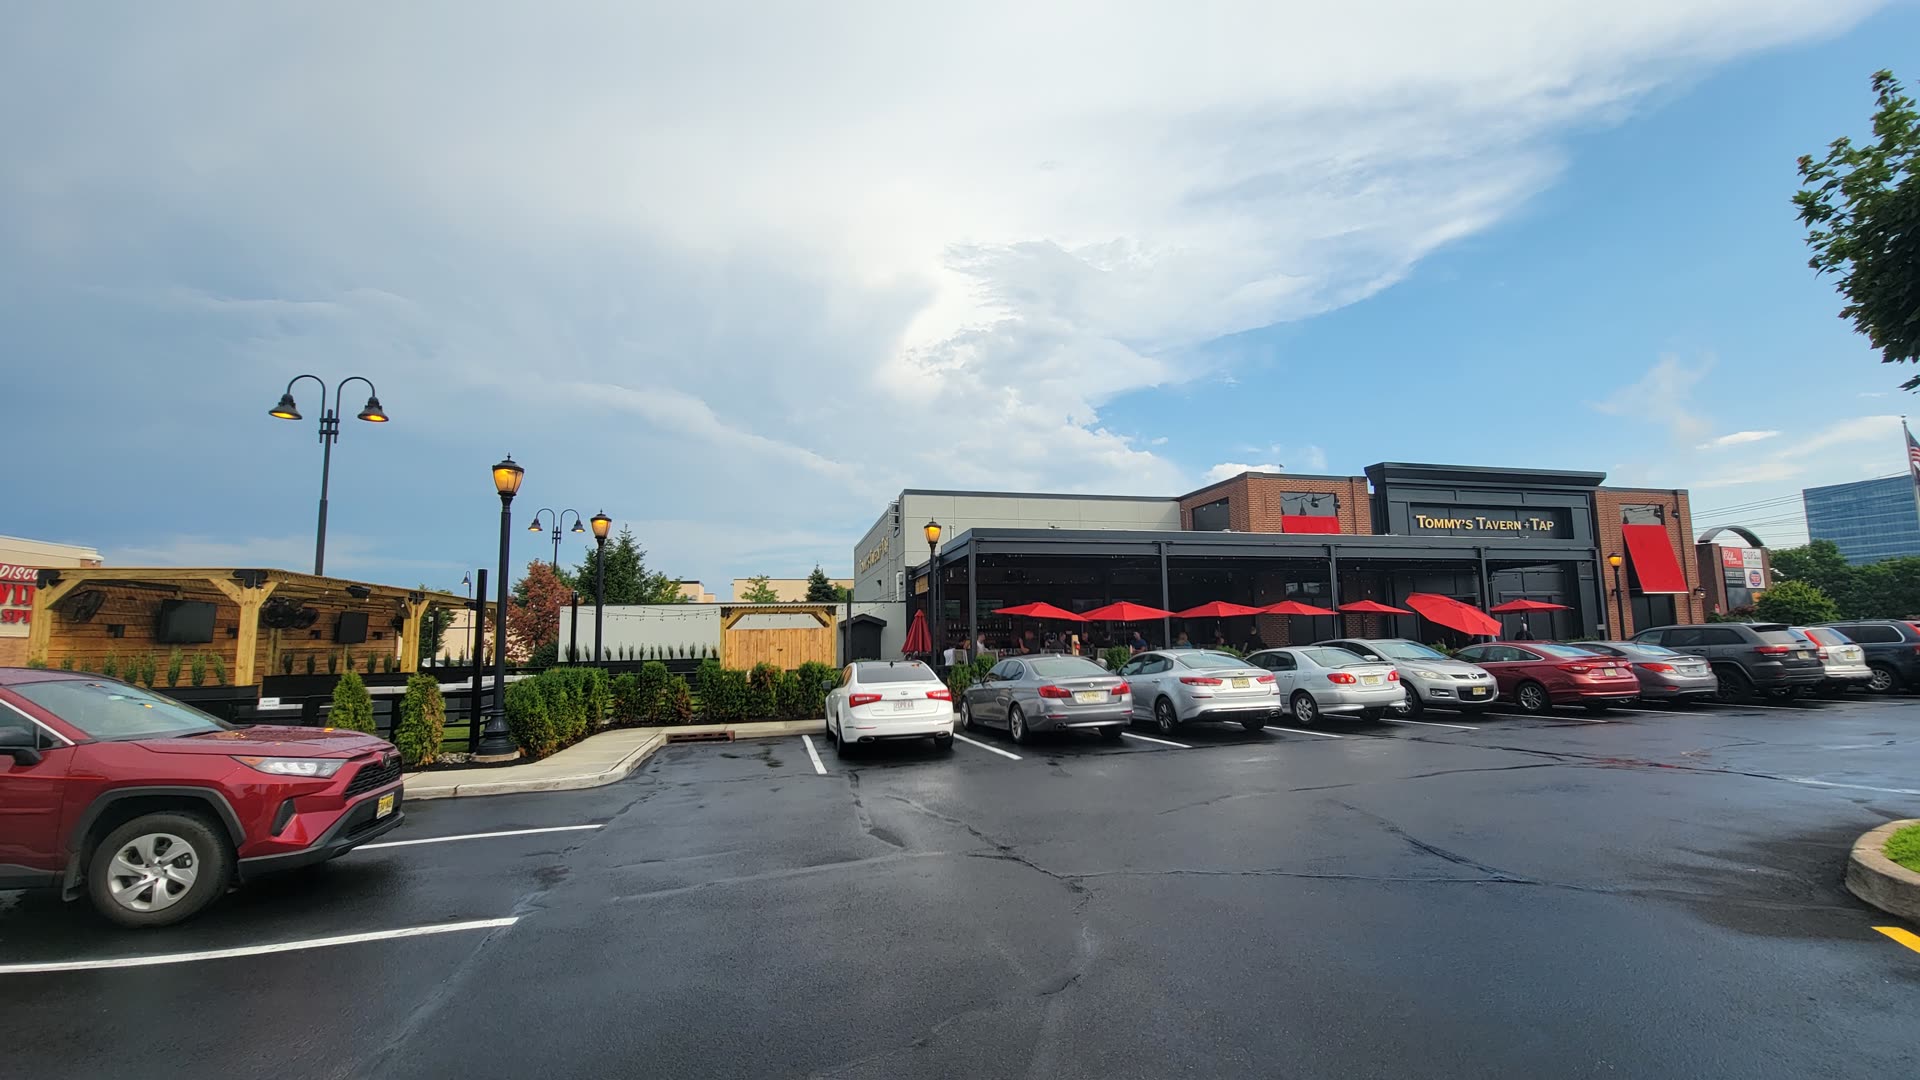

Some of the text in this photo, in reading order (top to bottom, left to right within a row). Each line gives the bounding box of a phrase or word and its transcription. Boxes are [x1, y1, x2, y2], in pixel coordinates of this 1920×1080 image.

[1416, 515, 1473, 530] TOMMY'S
[1475, 516, 1522, 530] TAVERN
[1530, 517, 1555, 531] TAP
